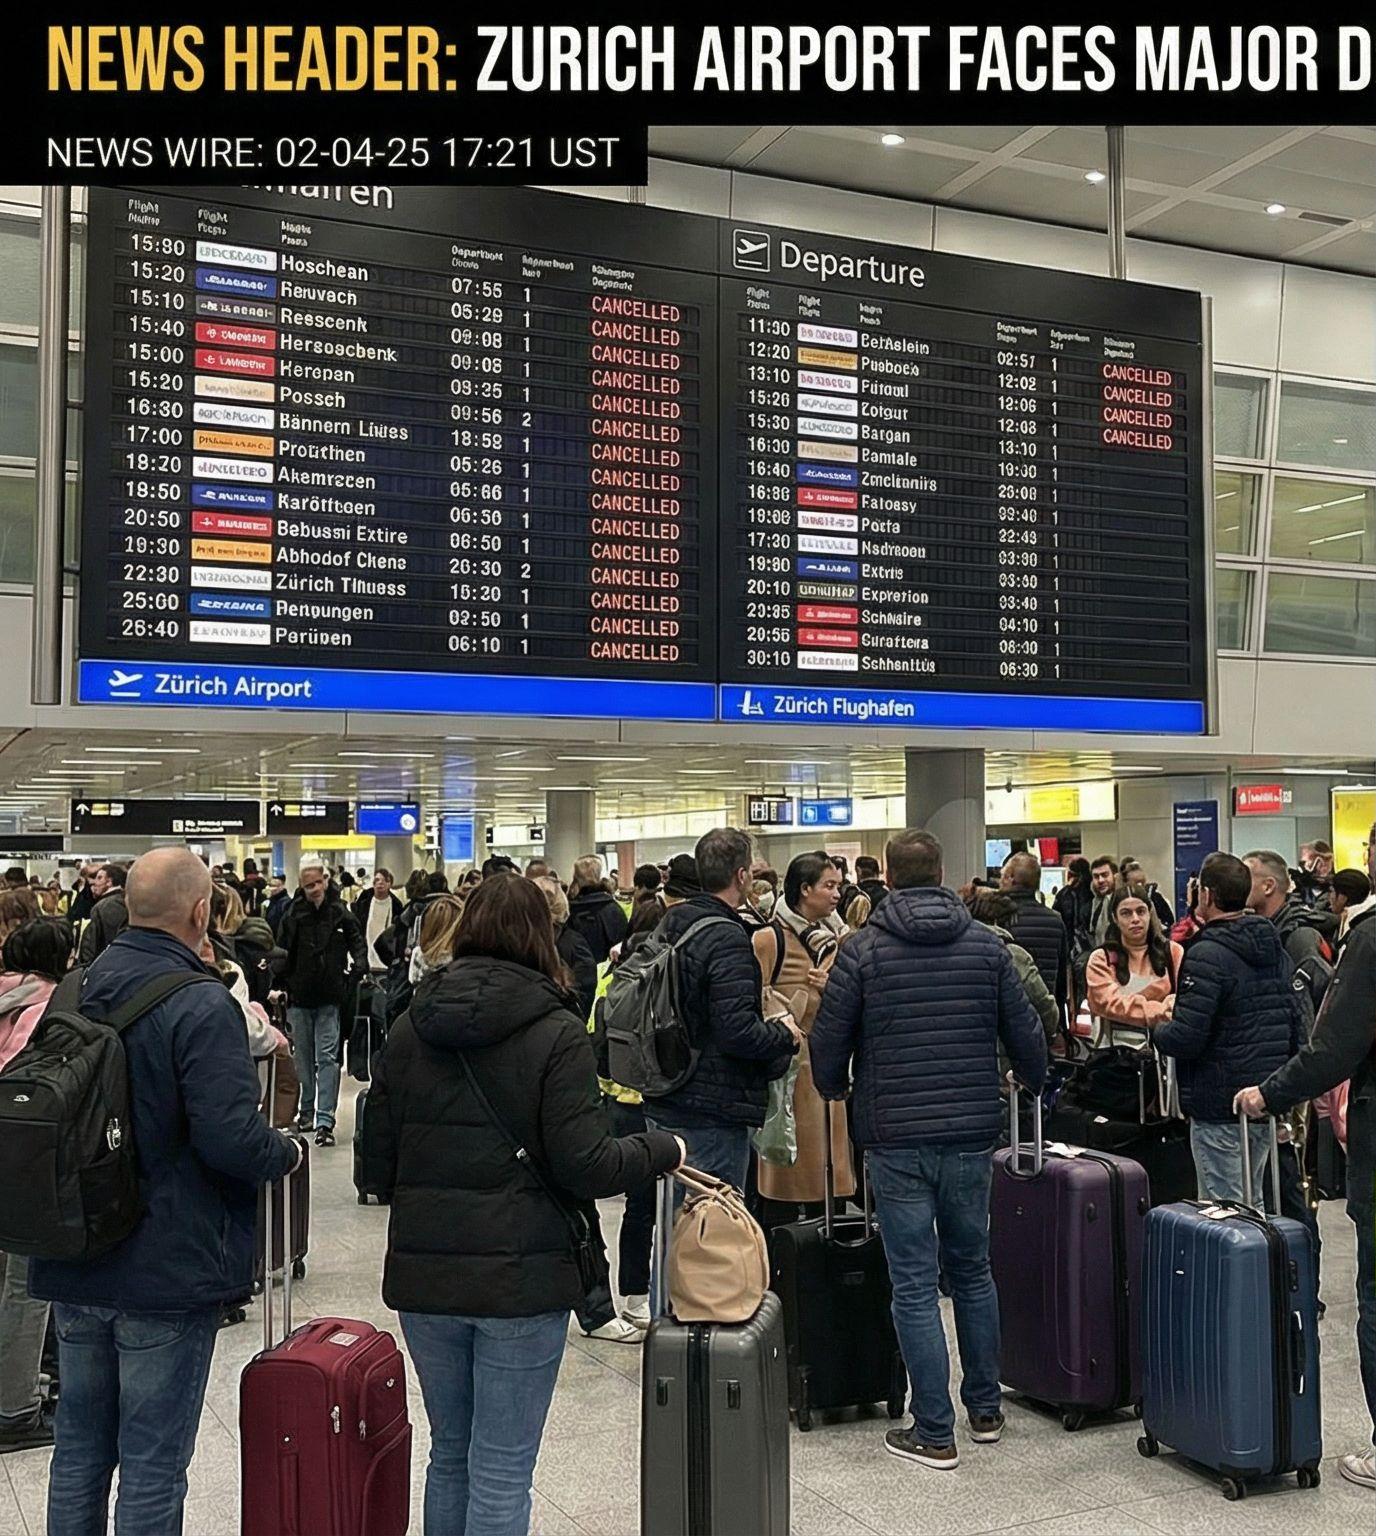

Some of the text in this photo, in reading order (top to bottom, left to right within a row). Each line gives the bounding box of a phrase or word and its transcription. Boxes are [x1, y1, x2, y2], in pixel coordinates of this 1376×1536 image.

[781, 241, 924, 287] Departure
[131, 261, 679, 350] 15:20 CANCELLED
[592, 296, 679, 326] CANCELLED
[131, 289, 679, 370] 15:10 CANCELLED
[130, 315, 679, 394] 15:40 CANCELLED
[129, 343, 680, 418] 15:00 CANCELLED
[1103, 364, 1171, 385] CANCELLED
[749, 366, 1171, 428] 13:10 CANCELLED
[1104, 386, 1171, 407] CANCELLED
[592, 419, 679, 442] CANCELLED
[1103, 429, 1171, 449] CANCELLED
[128, 425, 182, 445] 17:00
[592, 469, 679, 491] CANCELLED
[592, 444, 679, 467] CANCELLED
[592, 494, 679, 515] CANCELLED
[592, 518, 679, 539] CANCELLED
[592, 543, 679, 564] CANCELLED
[592, 568, 679, 587] CANCELLED
[276, 573, 333, 592] Zürich
[591, 592, 679, 612] CANCELLED
[591, 617, 679, 636] CANCELLED
[591, 642, 678, 661] CANCELLED
[155, 674, 311, 701] Zürich Airport
[774, 696, 914, 719] Zürich Flughafen
